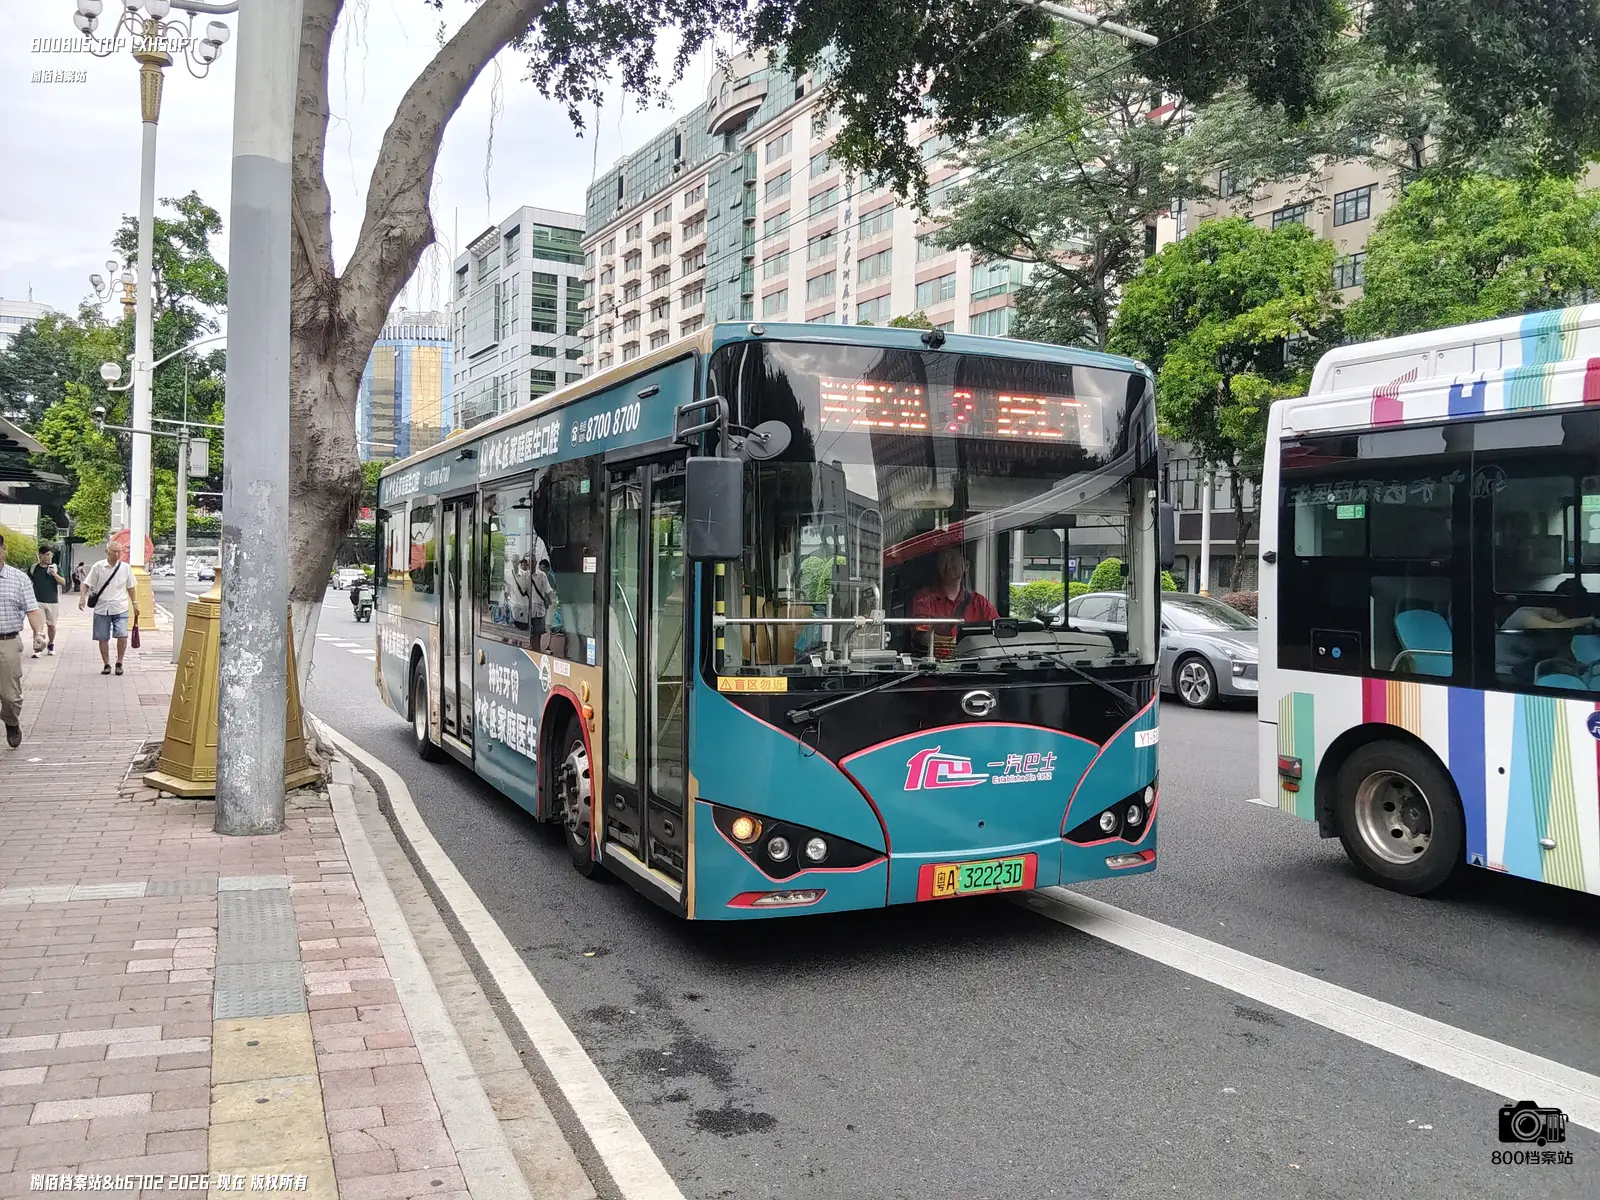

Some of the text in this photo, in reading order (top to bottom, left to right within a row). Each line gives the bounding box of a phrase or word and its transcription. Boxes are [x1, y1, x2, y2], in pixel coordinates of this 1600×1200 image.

[586, 411, 611, 443] 8700
[612, 402, 641, 436] 8700
[735, 678, 785, 691] 盲区勿近
[987, 751, 1057, 774] 一汽巴士
[992, 775, 1029, 784] Established
[1036, 772, 1053, 781] 1952
[963, 863, 1023, 889] 32223D
